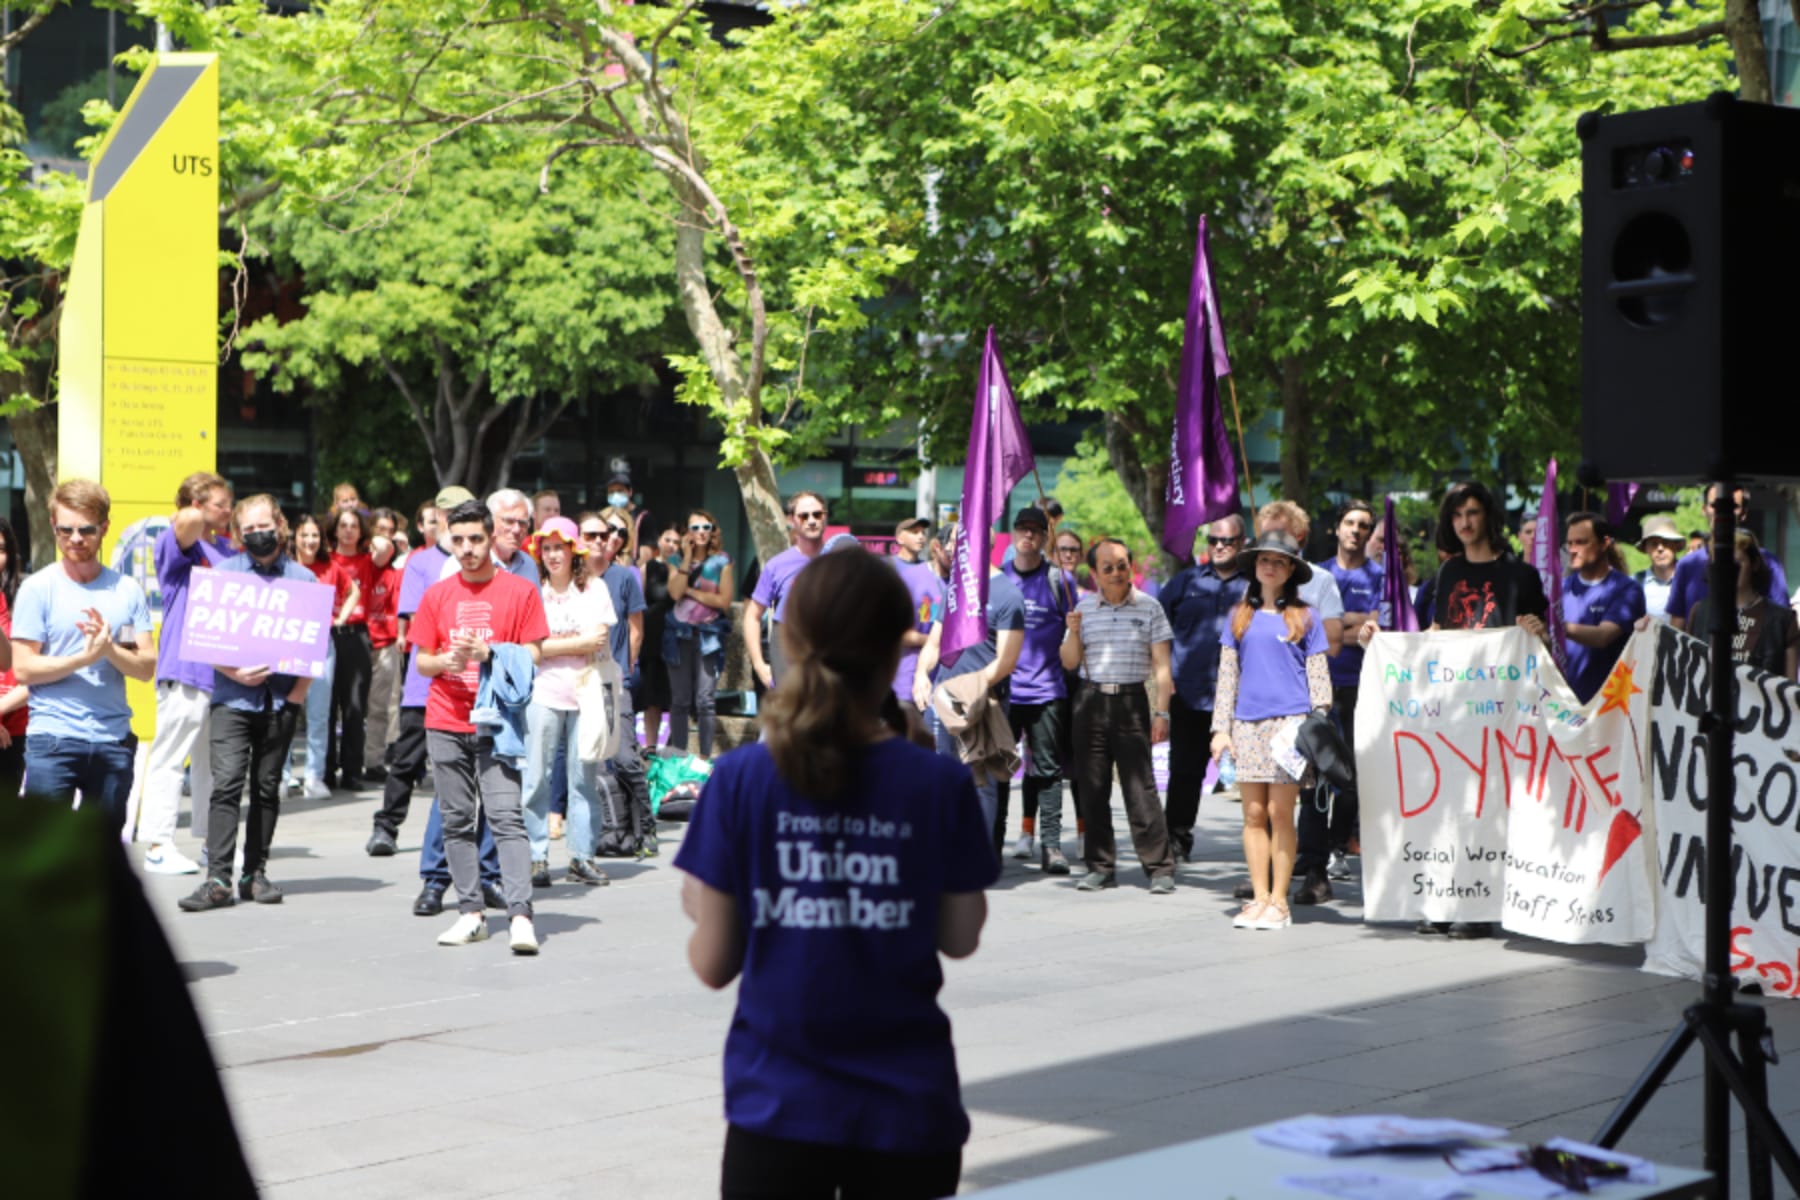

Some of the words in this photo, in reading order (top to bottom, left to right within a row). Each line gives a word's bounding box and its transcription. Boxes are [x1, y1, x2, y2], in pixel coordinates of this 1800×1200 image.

[173, 154, 212, 176] UTS
[957, 539, 983, 618] Tertiary
[191, 579, 213, 602] A
[219, 582, 289, 612] FAIR
[188, 606, 249, 634] PAY
[252, 614, 321, 645] RISE
[1427, 660, 1521, 684] EDUCATED
[1389, 700, 1441, 718] NOW
[1466, 701, 1504, 716] THAT
[1732, 753, 1800, 833] CO
[776, 811, 839, 835] Proud
[845, 814, 865, 836] to
[869, 815, 895, 838] be
[900, 822, 912, 838] a
[776, 840, 899, 885] Union
[1403, 841, 1454, 863] Social
[1413, 873, 1491, 898] Students
[753, 887, 914, 930] Member
